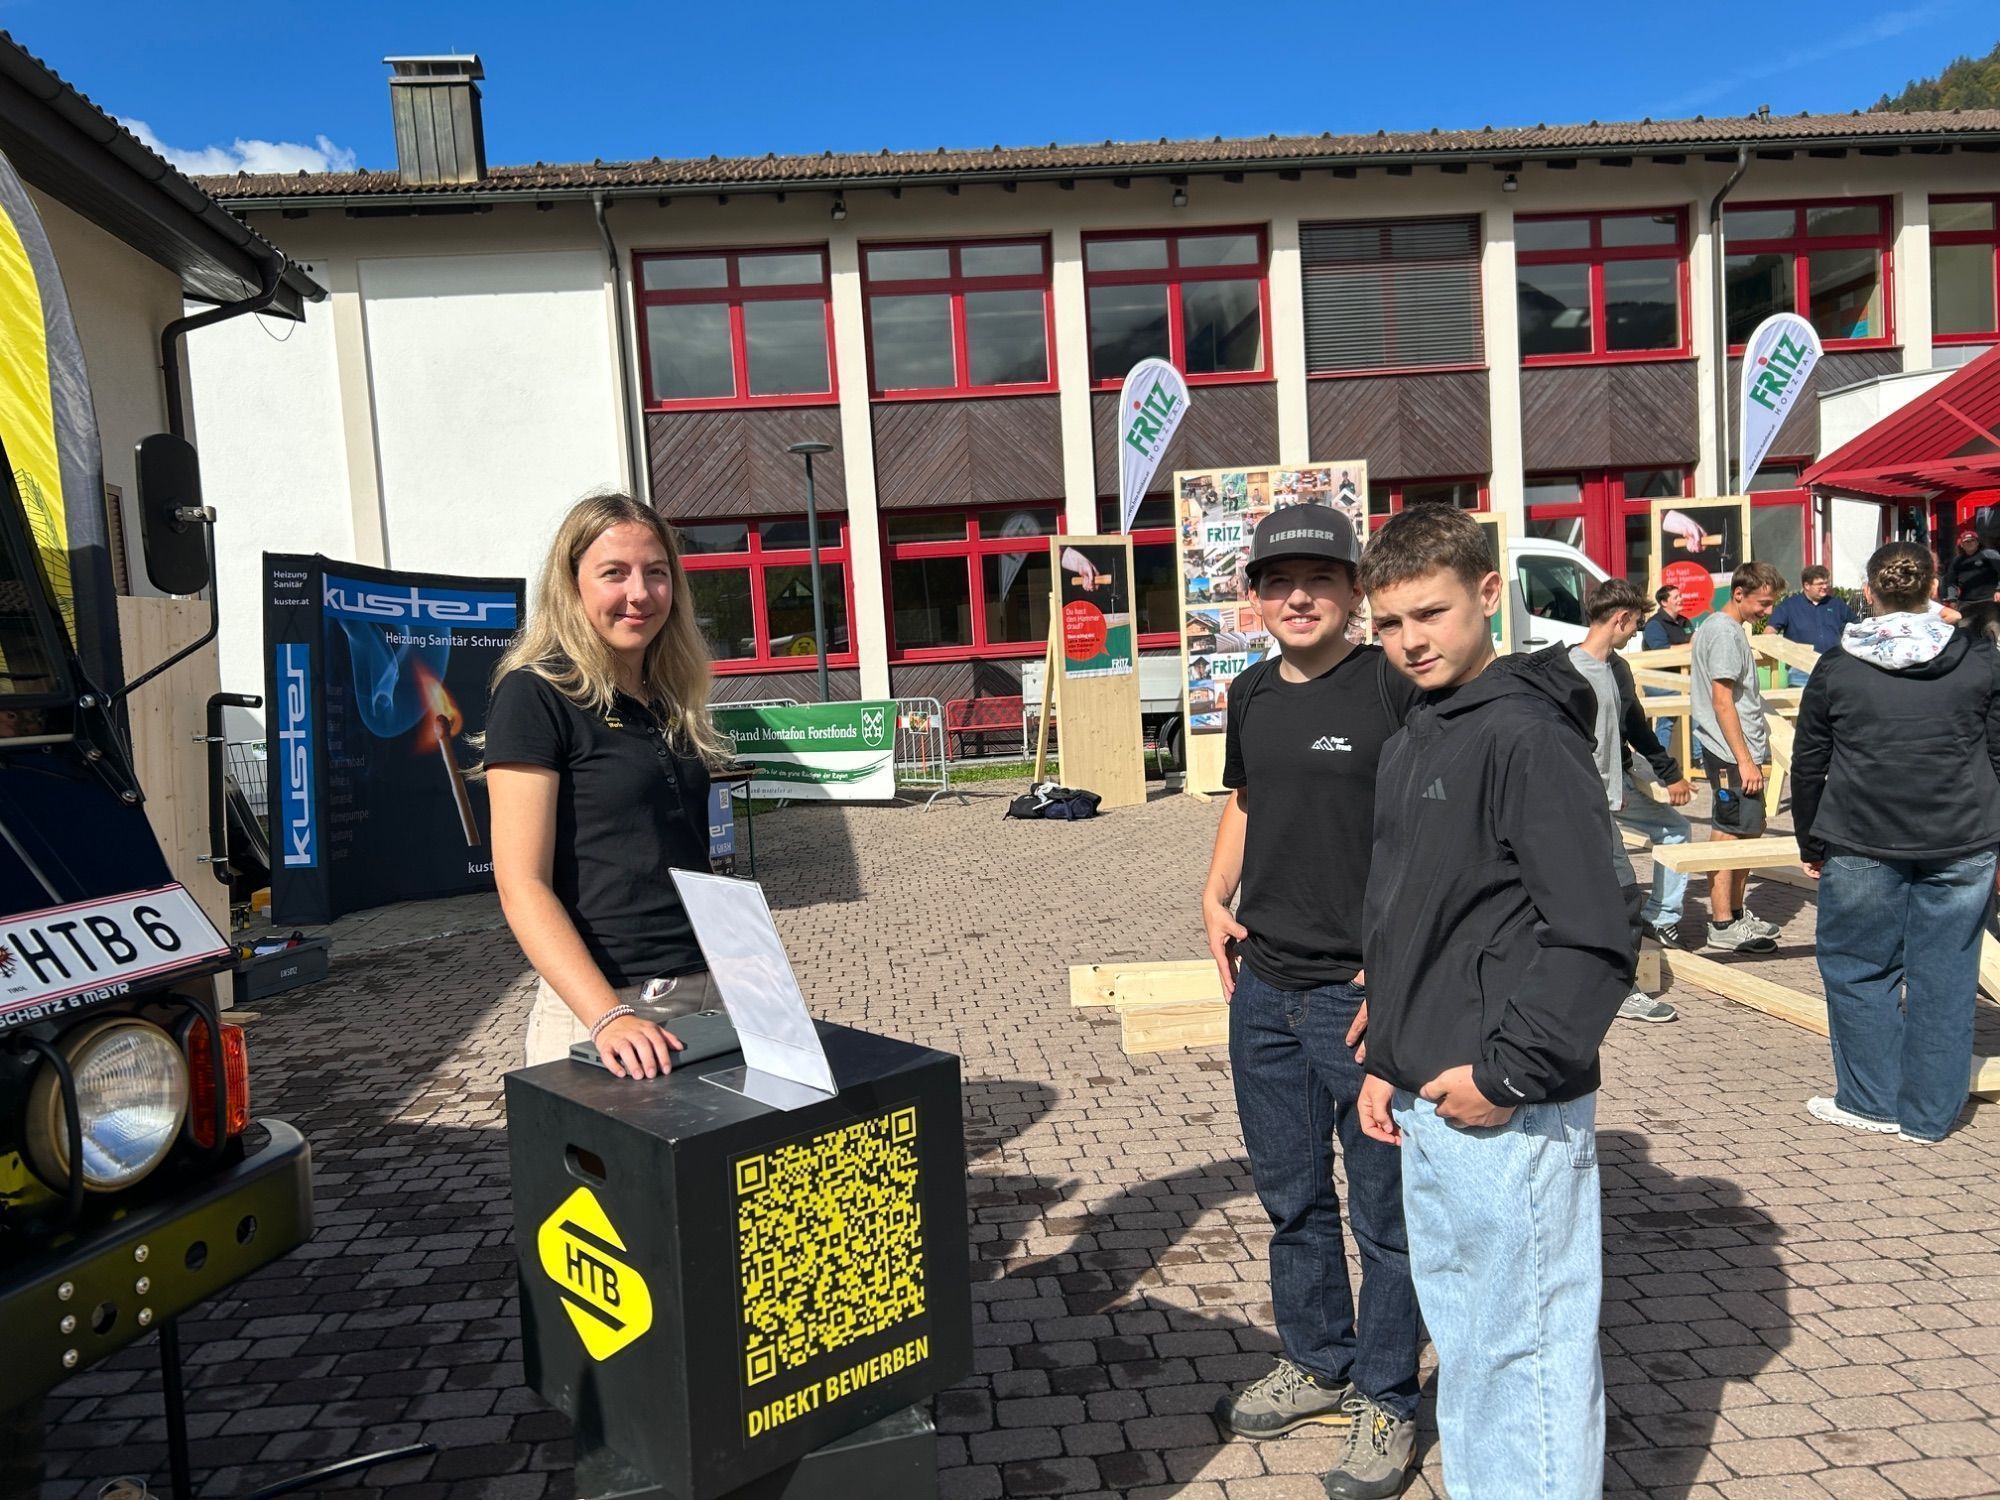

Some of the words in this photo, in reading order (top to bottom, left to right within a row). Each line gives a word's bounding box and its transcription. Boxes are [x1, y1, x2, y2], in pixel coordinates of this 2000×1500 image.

[1749, 332, 1807, 411] FRITZ
[1775, 348, 1815, 416] HOLZBAU
[1126, 380, 1178, 458] FRITZ
[1148, 399, 1183, 463] HOLZBAU
[1206, 523, 1241, 543] FRITZ
[1269, 529, 1335, 544] LIEBHERR
[273, 571, 308, 580] Heizung
[273, 581, 304, 589] Sanitär
[274, 598, 310, 606] kuster.at
[322, 571, 517, 622] kuster
[386, 631, 427, 649] Heizung
[428, 633, 469, 648] Sanitär
[1212, 655, 1248, 675] FRITZ
[729, 728, 760, 743] Stand
[762, 725, 806, 741] Montafon
[808, 724, 858, 740] Forstfonds
[279, 643, 311, 865] kuster
[468, 861, 495, 874] kust
[8, 916, 138, 984] HTB
[133, 905, 182, 952] 6
[8, 985, 28, 994] TIROL
[69, 995, 81, 1008] &
[566, 1242, 621, 1307] HTB
[748, 1382, 821, 1438] DIREKT
[826, 1335, 929, 1402] BEWERBEN
